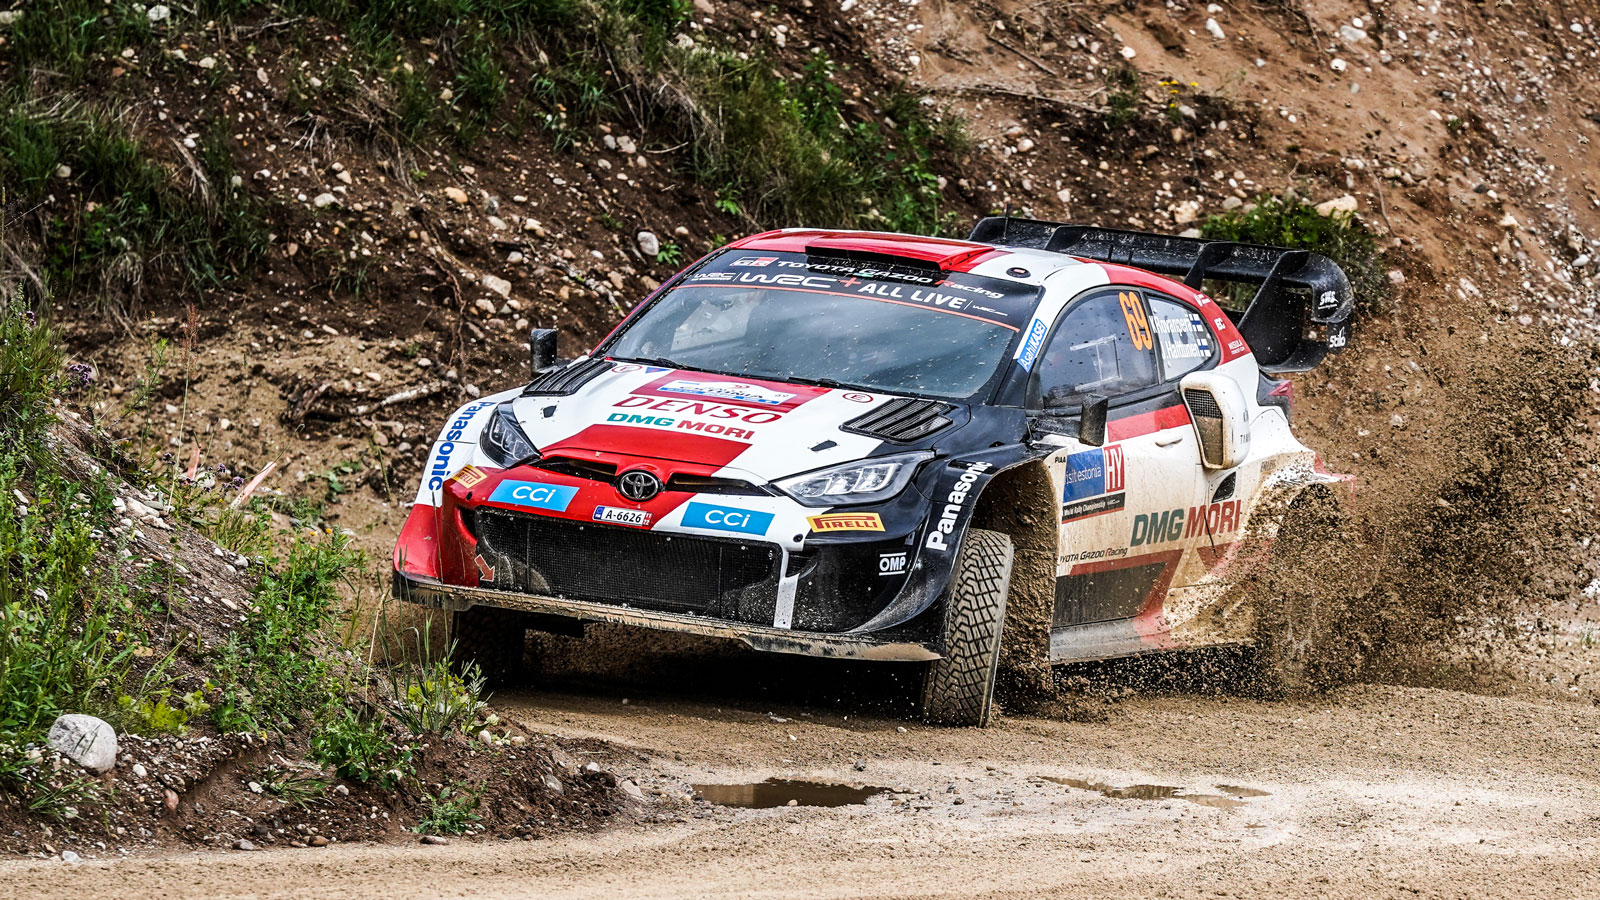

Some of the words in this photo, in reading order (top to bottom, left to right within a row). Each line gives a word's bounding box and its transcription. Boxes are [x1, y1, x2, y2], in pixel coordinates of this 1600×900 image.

[777, 260, 855, 273] TOYOTA
[858, 268, 933, 283] GAZOO
[934, 280, 1005, 299] Racing
[858, 283, 903, 298] ALL
[910, 290, 967, 309] LIVE
[1119, 292, 1152, 351] 69
[612, 396, 782, 424] DENSO
[607, 413, 675, 427] DMG
[677, 420, 755, 440] MORI
[428, 401, 498, 491] Panasonic
[1065, 469, 1077, 484] isit
[1077, 465, 1102, 482] estonia
[1104, 447, 1121, 490] HY
[605, 510, 642, 523] A-6626
[926, 461, 993, 551] Panasonic
[812, 515, 878, 530] PIRELLI
[1130, 508, 1185, 547] DMG
[1185, 500, 1242, 539] MORI
[878, 557, 906, 573] OMP
[1060, 553, 1079, 563] YOTA
[1080, 550, 1105, 560] GAZOO
[1105, 546, 1128, 558] Racing
